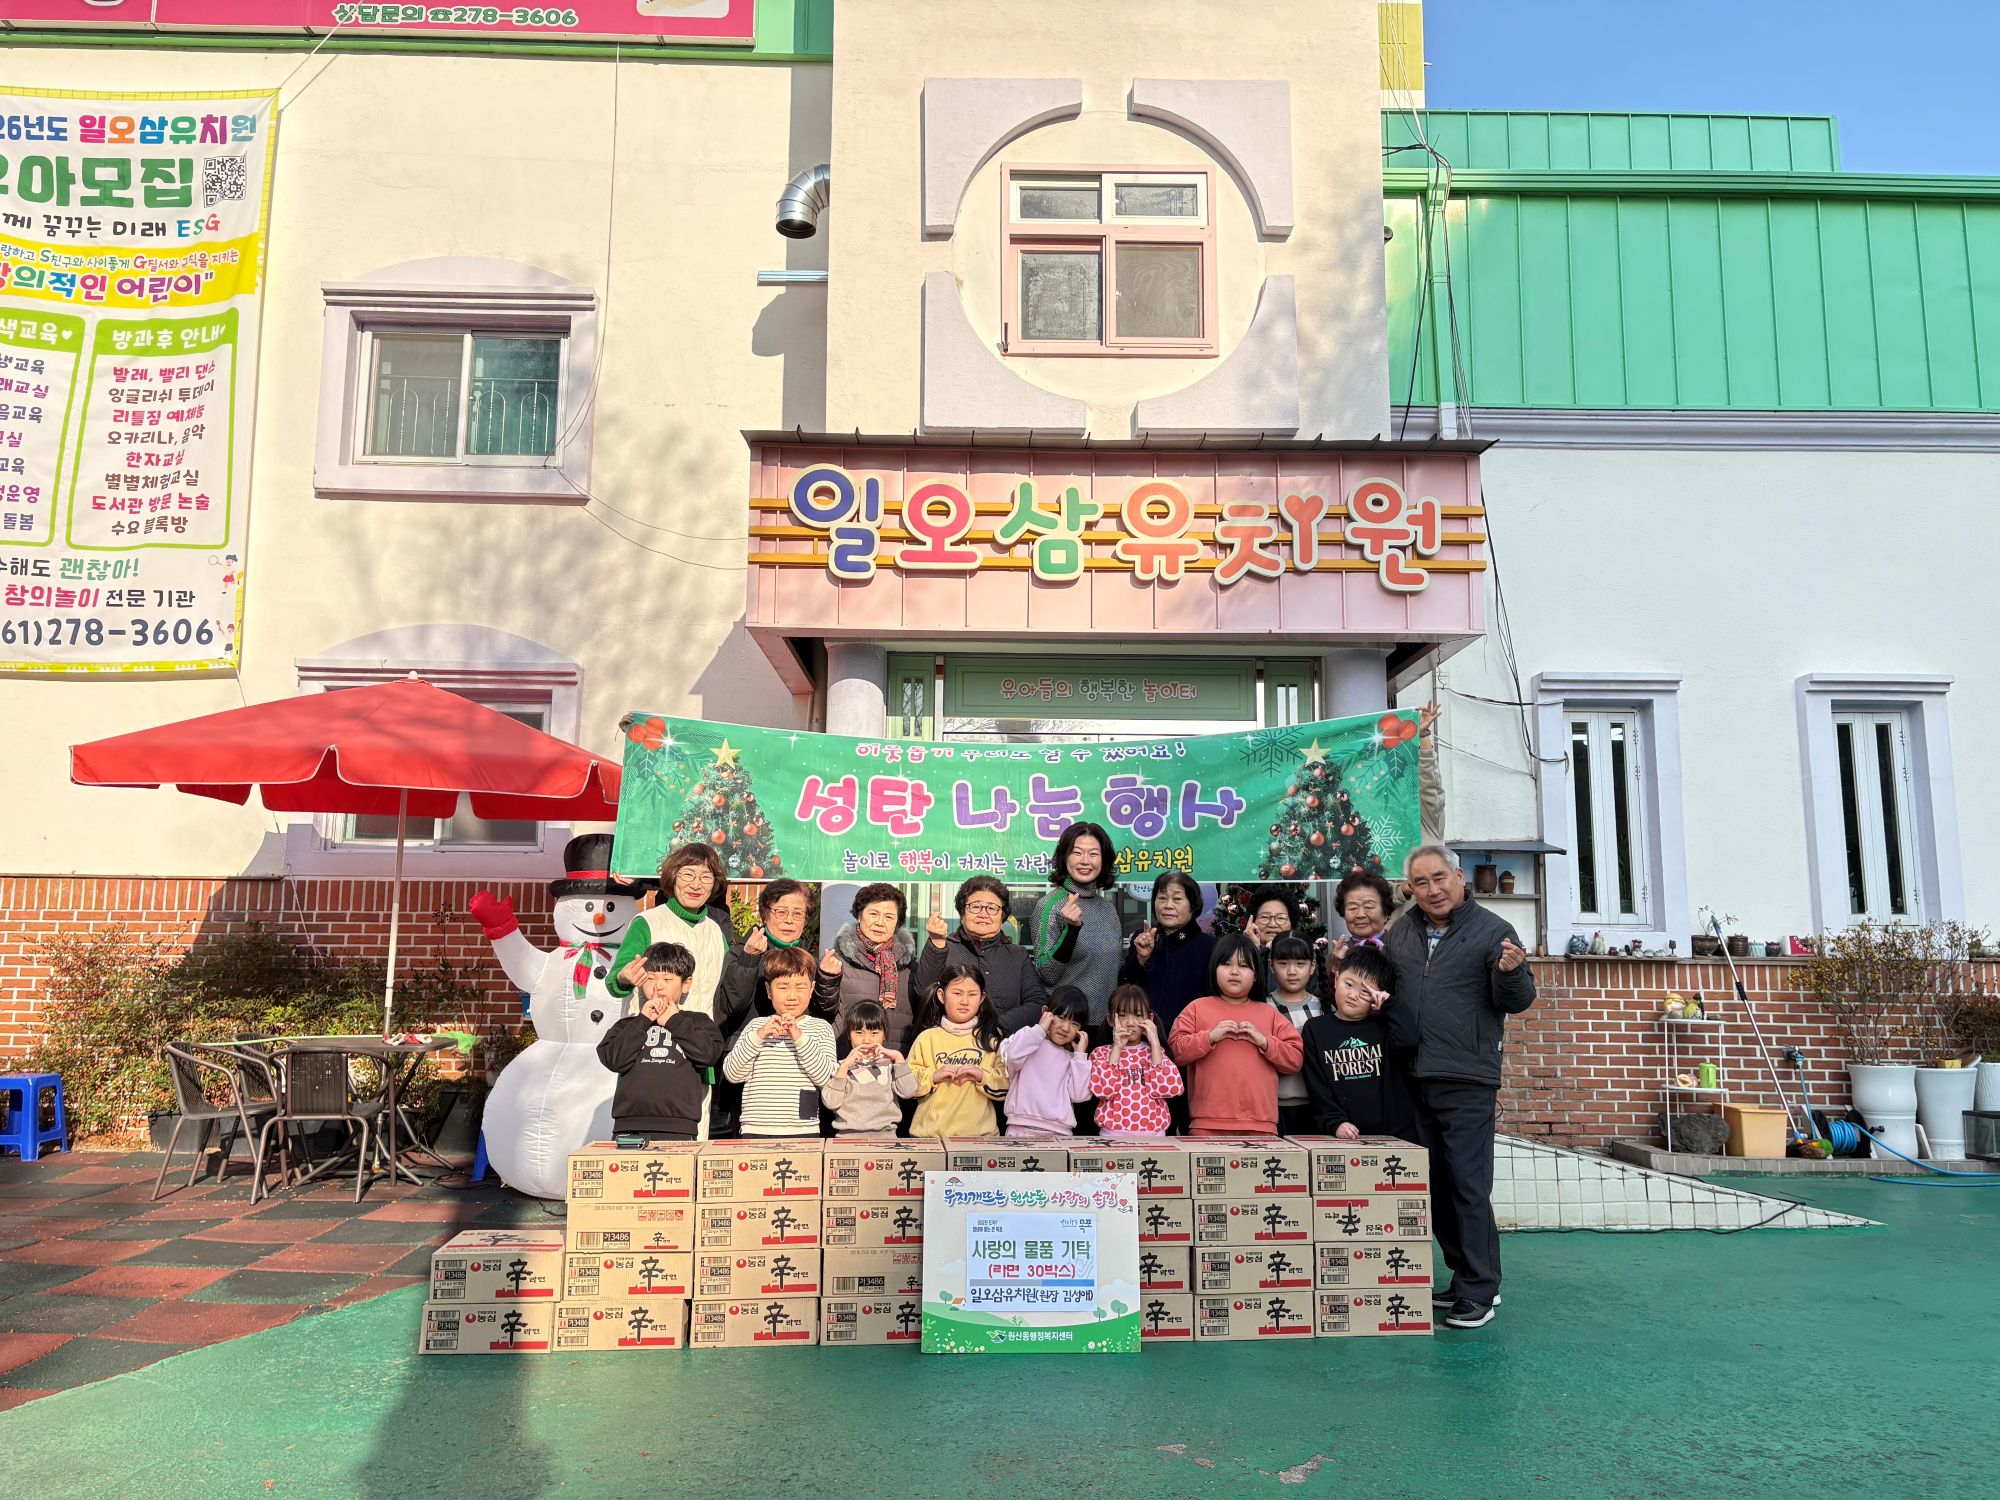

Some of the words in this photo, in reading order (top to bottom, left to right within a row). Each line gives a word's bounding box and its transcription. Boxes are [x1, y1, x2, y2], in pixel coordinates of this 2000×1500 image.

[335, 5, 424, 23] 상담문의
[453, 7, 577, 26] 278-3606
[79, 114, 257, 144] 일오삼유치원
[0, 154, 194, 208] 아모집
[43, 214, 102, 238] 꿈꾸는
[113, 222, 167, 237] 미래
[177, 213, 221, 238] ESG
[40, 249, 84, 268] S친구와
[87, 256, 130, 272] 사이좋게
[133, 255, 179, 271] G질서와
[211, 249, 239, 264] 지키는
[112, 329, 174, 350] 방과후
[180, 324, 220, 349] 안내
[113, 366, 153, 383] 발레,
[159, 365, 190, 383] 밸리
[195, 360, 216, 380] 댄스
[108, 388, 173, 405] 잉글리쉬
[178, 379, 215, 402] 투데이
[113, 409, 161, 426] 리틀짐
[166, 404, 205, 422] 예체능
[0, 430, 23, 448] 실
[107, 430, 177, 446] 오카리나,
[181, 424, 206, 445] 음악
[126, 449, 185, 468] 한자교실
[105, 469, 199, 491] 별별체험교실
[92, 495, 144, 515] 도서관
[148, 493, 172, 513] 방문
[178, 492, 210, 511] 논술
[4, 512, 34, 531] 돌봄
[111, 520, 140, 536] 수요
[143, 515, 189, 535] 블록방
[790, 464, 1441, 592] 일오삼유치원
[60, 557, 140, 581] 괜찮아!
[5, 584, 100, 608] 창의놀이
[105, 589, 146, 608] 전문
[153, 589, 196, 608] 기관
[2, 618, 214, 647] 61)278-3606
[1001, 677, 1073, 701] 유아들의
[1079, 678, 1137, 702] 행복한
[1142, 679, 1198, 702] 놀이터
[1071, 748, 1093, 762] 수
[796, 776, 934, 836] 성탄
[955, 775, 1083, 840] 나눔
[1103, 774, 1246, 840] 행사
[843, 850, 891, 873] 놀이로
[899, 850, 949, 874] 행복이
[958, 853, 1007, 875] 커지는
[1113, 846, 1193, 874] 삼유치원
[936, 1048, 983, 1066] Rainbow
[1324, 1043, 1383, 1064] NATIONAL
[1332, 1057, 1382, 1081] FOREST
[621, 1164, 639, 1172] 농심
[750, 1163, 768, 1171] 농심
[876, 1162, 894, 1171] 농심
[998, 1160, 1016, 1169] 농심
[1117, 1161, 1135, 1170] 농심
[1241, 1161, 1258, 1169] 농심
[1361, 1159, 1378, 1167] 농심
[944, 1189, 1007, 1206] 무지개뜨는
[1010, 1189, 1047, 1206] 원산동
[1051, 1190, 1087, 1206] 사랑의
[1092, 1190, 1116, 1206] 손길
[749, 1211, 767, 1220] 농심
[871, 1211, 889, 1219] 농심
[1241, 1208, 1259, 1216] 농심
[971, 1240, 1016, 1259] 사랑의
[1024, 1240, 1054, 1259] 물품
[1061, 1240, 1091, 1259] 기탁
[483, 1263, 502, 1272] 농심
[616, 1261, 635, 1269] 농심
[748, 1260, 766, 1268] 농심
[988, 1264, 1020, 1278] (라면
[1027, 1264, 1076, 1278] 30박스)
[741, 1307, 760, 1315] 농심
[1245, 1302, 1262, 1310] 농심
[1364, 1298, 1382, 1306] 농심
[478, 1314, 497, 1323] 농심
[605, 1311, 624, 1320] 농심
[1008, 1331, 1073, 1341] 원산동행정복지센터
